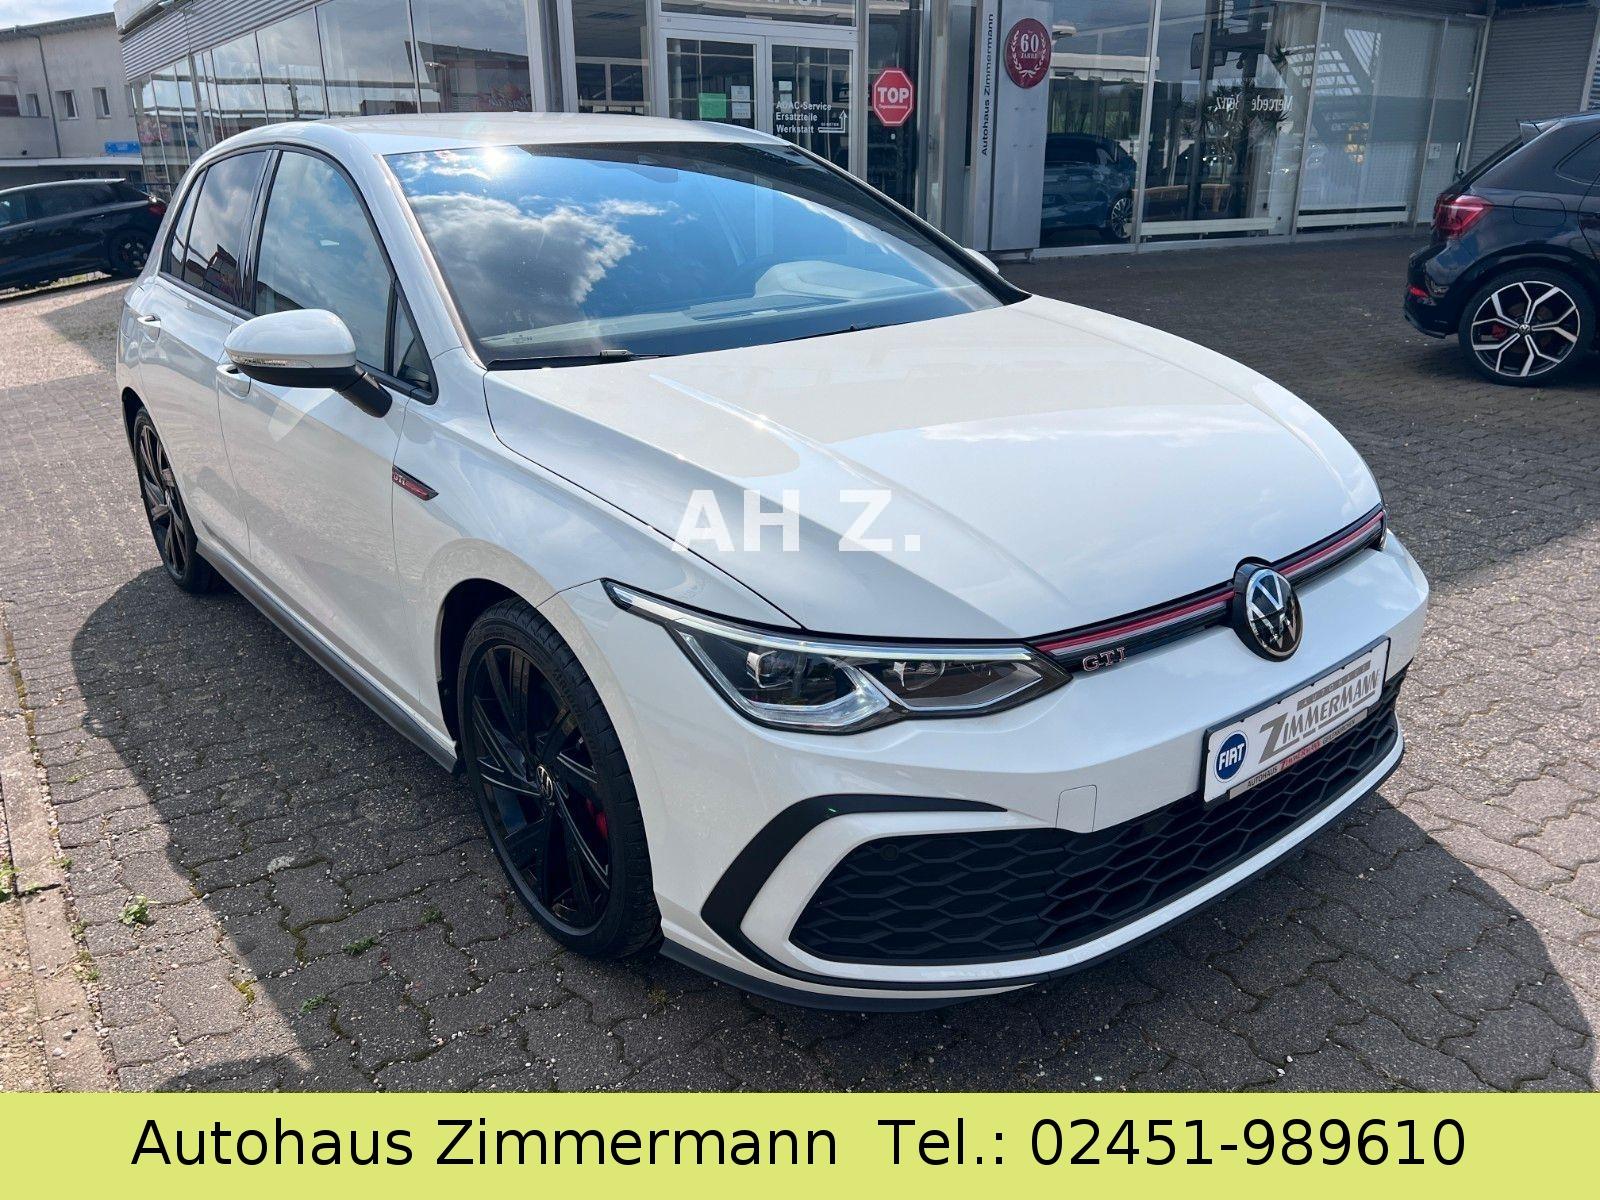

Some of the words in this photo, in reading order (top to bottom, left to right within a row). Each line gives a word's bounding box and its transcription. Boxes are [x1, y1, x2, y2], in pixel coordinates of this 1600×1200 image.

[984, 13, 994, 96] Zimmermann
[1020, 33, 1040, 53] 60
[877, 86, 910, 104] TOP
[775, 112, 818, 122] Ersatzteile
[776, 124, 815, 134] Werkstatt
[981, 99, 990, 156] Autohaus
[1082, 646, 1128, 672] GTI
[1258, 668, 1381, 765] ZIMMERMANN
[1217, 742, 1246, 772] FIAT
[1247, 765, 1279, 789] AUTOHAUS
